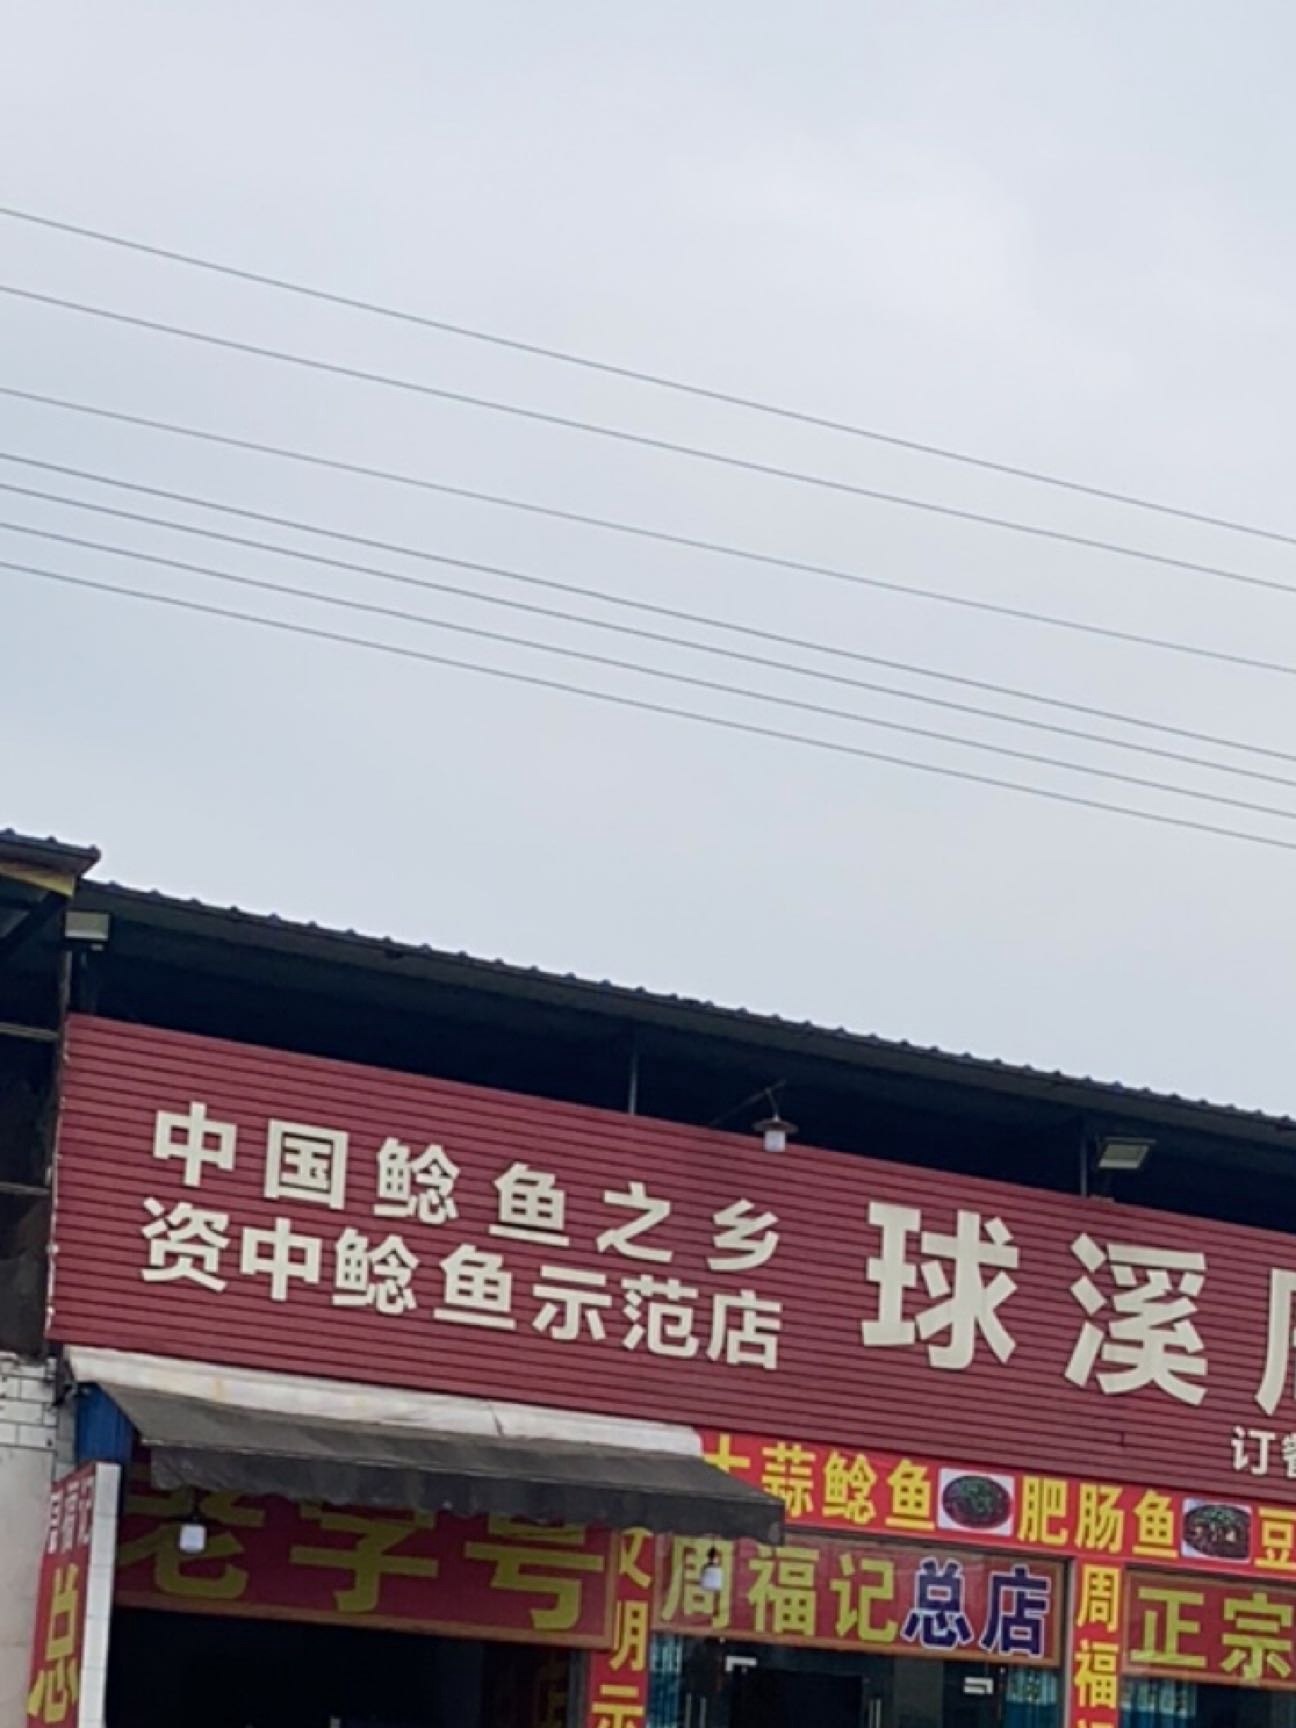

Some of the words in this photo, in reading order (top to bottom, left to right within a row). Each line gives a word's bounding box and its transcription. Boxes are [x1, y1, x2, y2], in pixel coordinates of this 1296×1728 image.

[152, 1101, 780, 1271] 中国鲶鱼之乡
[140, 1197, 783, 1370] 资中鲶鱼示范店
[1016, 1475, 1178, 1560] 肥肠鱼
[661, 1535, 1053, 1660] 周福记总店
